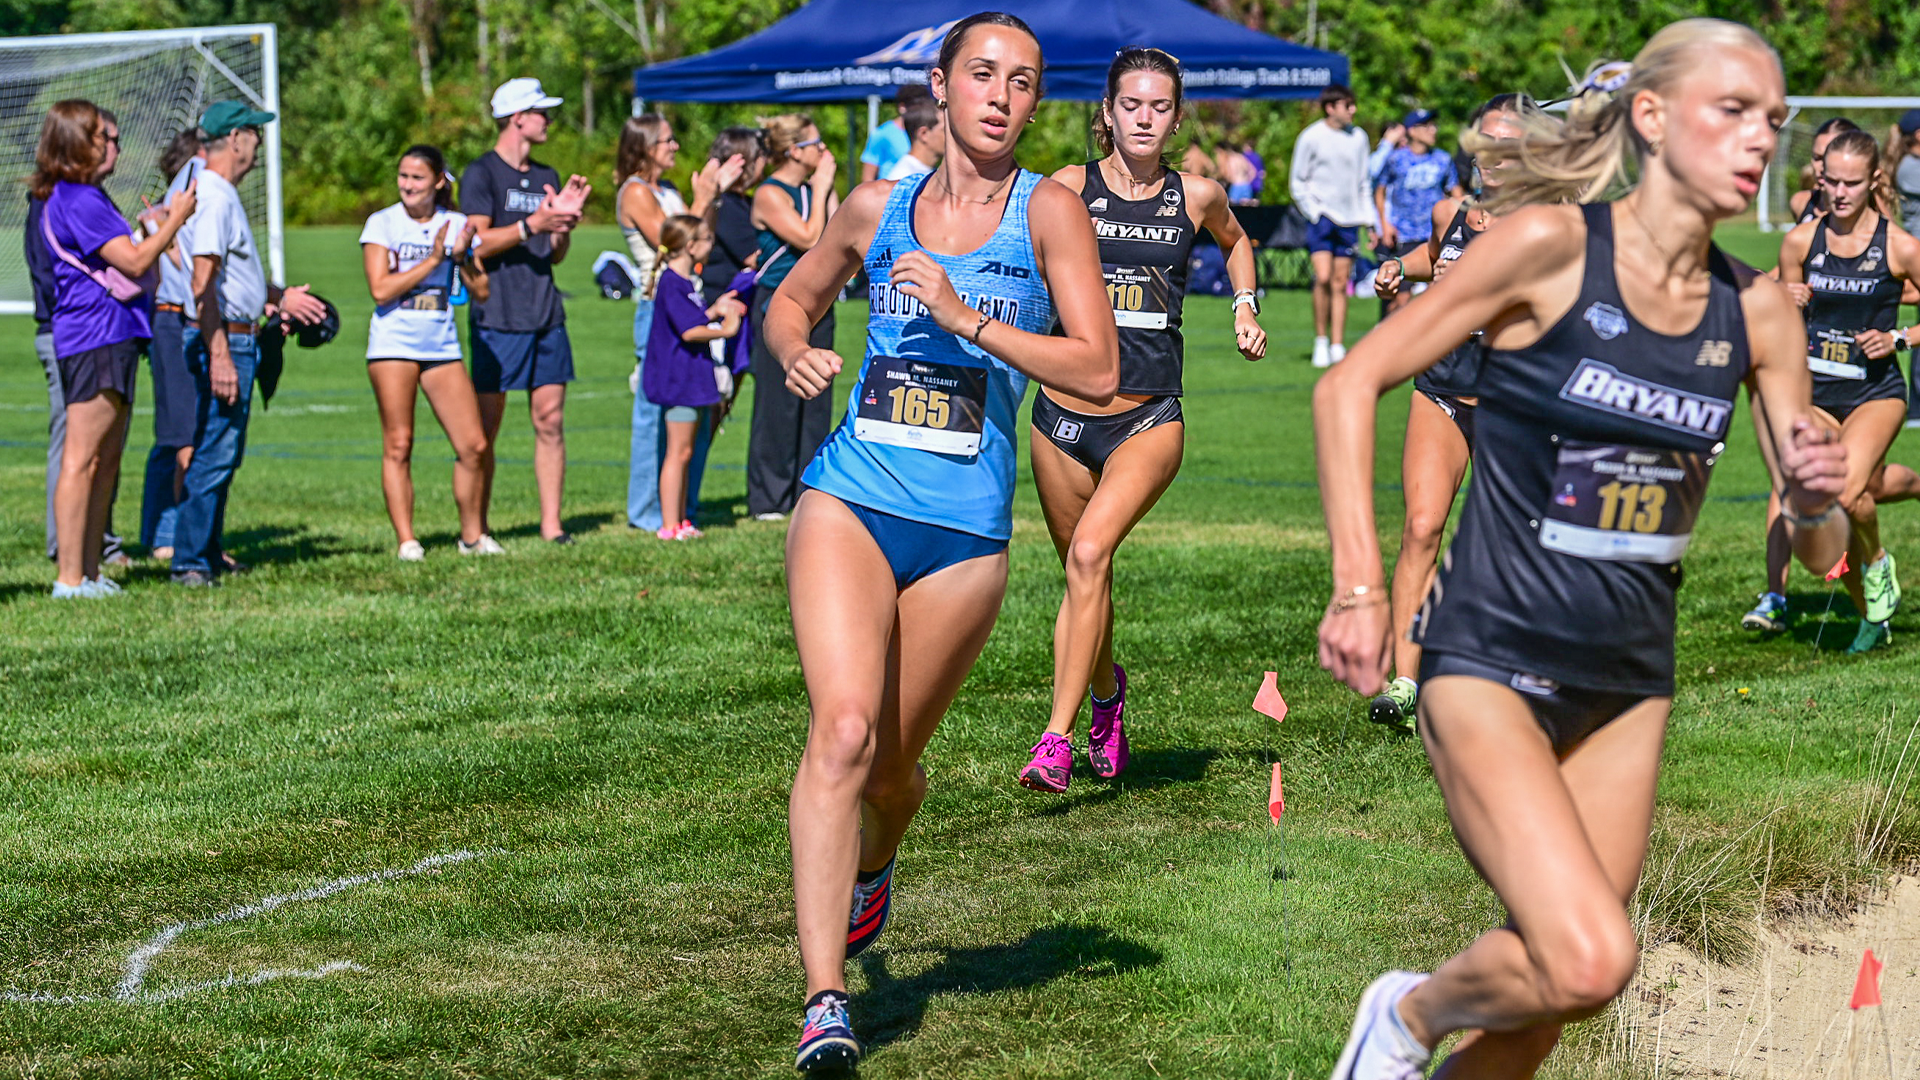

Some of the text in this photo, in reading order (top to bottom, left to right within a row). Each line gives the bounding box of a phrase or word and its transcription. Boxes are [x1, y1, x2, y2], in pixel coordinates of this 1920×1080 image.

[976, 260, 1031, 279] A10
[1106, 283, 1143, 311] 110
[1820, 341, 1849, 363] 115
[923, 376, 958, 388] NASSANEY
[888, 385, 950, 429] 165
[1569, 364, 1728, 435] BRYANT
[1056, 420, 1080, 440] B
[1598, 481, 1667, 533] 113
